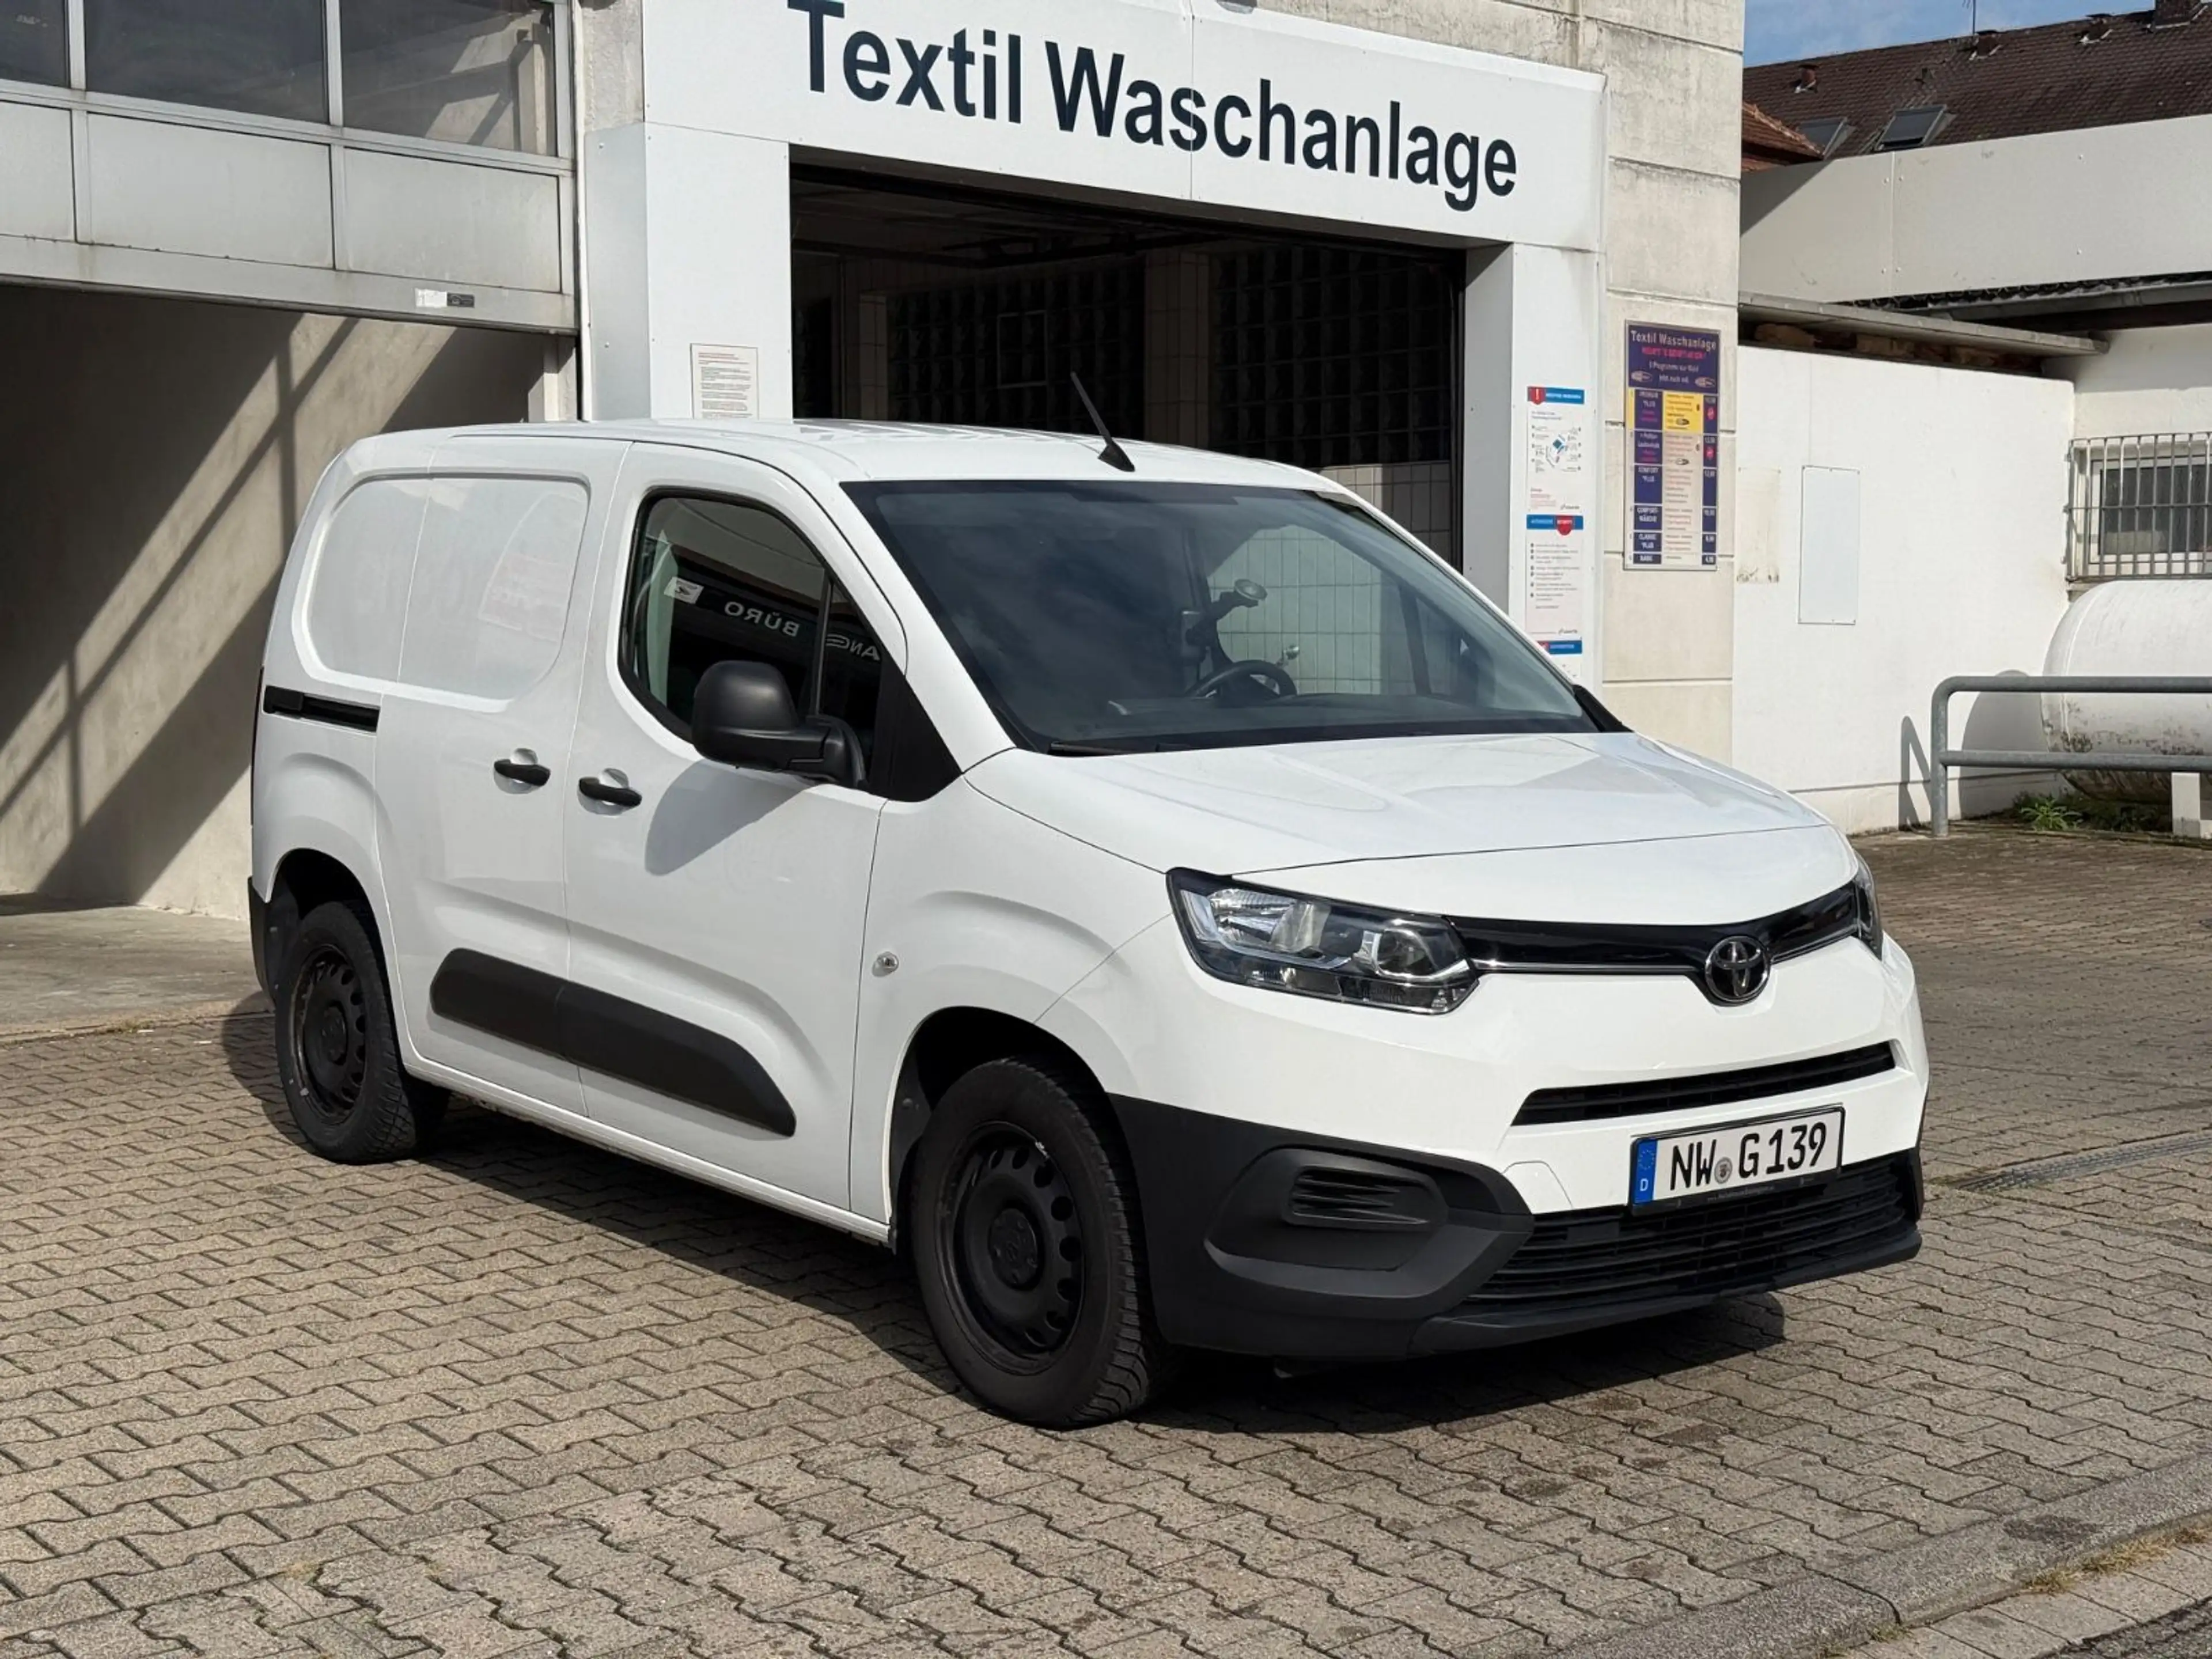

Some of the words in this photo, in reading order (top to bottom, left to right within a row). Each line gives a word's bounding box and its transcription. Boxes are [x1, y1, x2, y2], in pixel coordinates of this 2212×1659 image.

[787, 0, 1021, 123] Textil
[1045, 40, 1517, 211] Waschanlage
[1630, 329, 1657, 344] Textil
[1658, 332, 1717, 352] Waschanlage
[1670, 1139, 1717, 1191] NW
[1639, 1179, 1649, 1192] D
